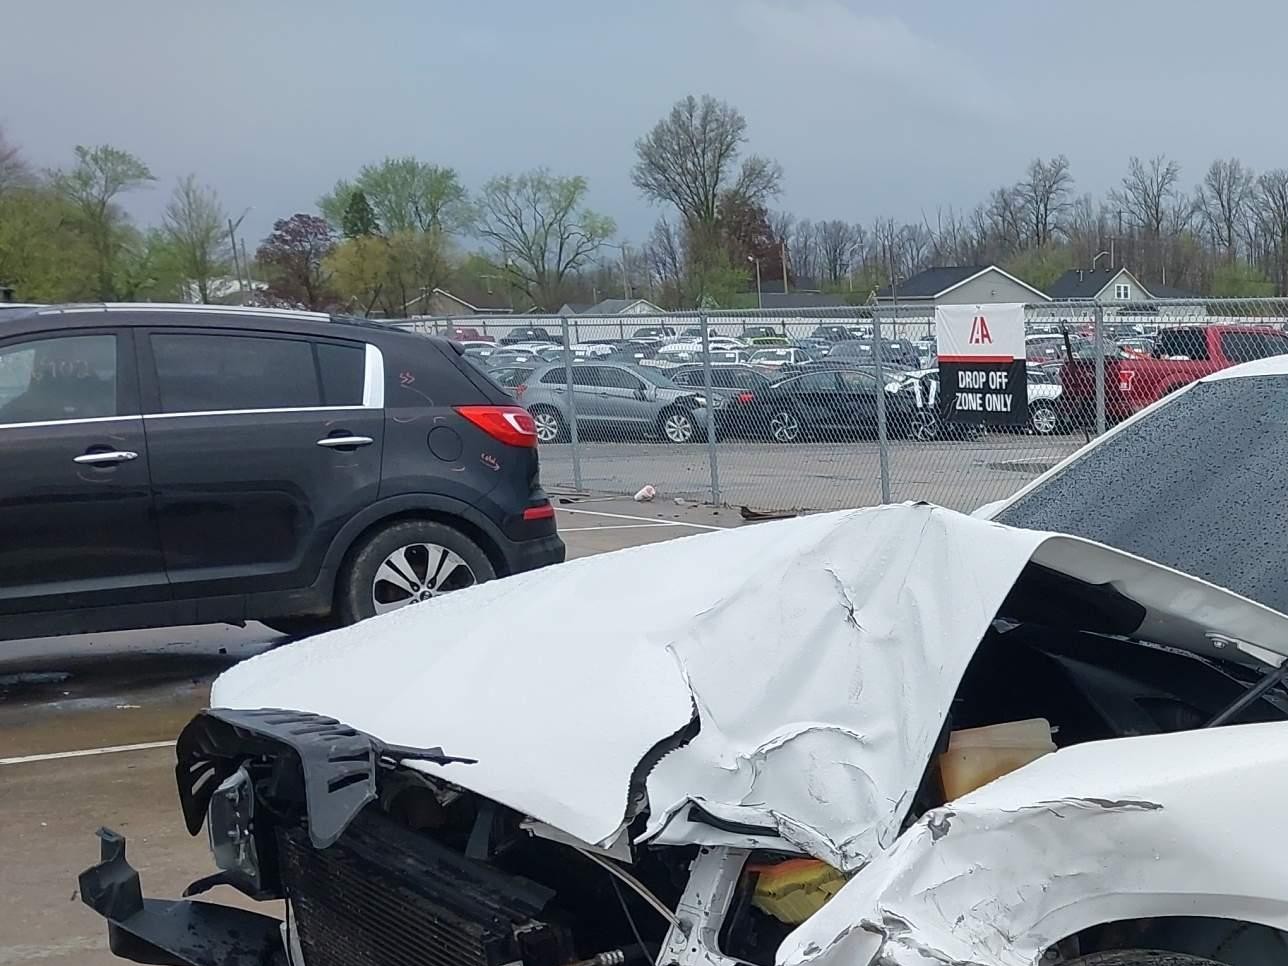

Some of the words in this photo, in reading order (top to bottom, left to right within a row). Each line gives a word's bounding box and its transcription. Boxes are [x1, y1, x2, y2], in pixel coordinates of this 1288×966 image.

[958, 371, 987, 389] DROP
[989, 371, 1009, 390] OFF
[955, 393, 984, 411] ZONE
[985, 394, 1013, 412] ONLY
